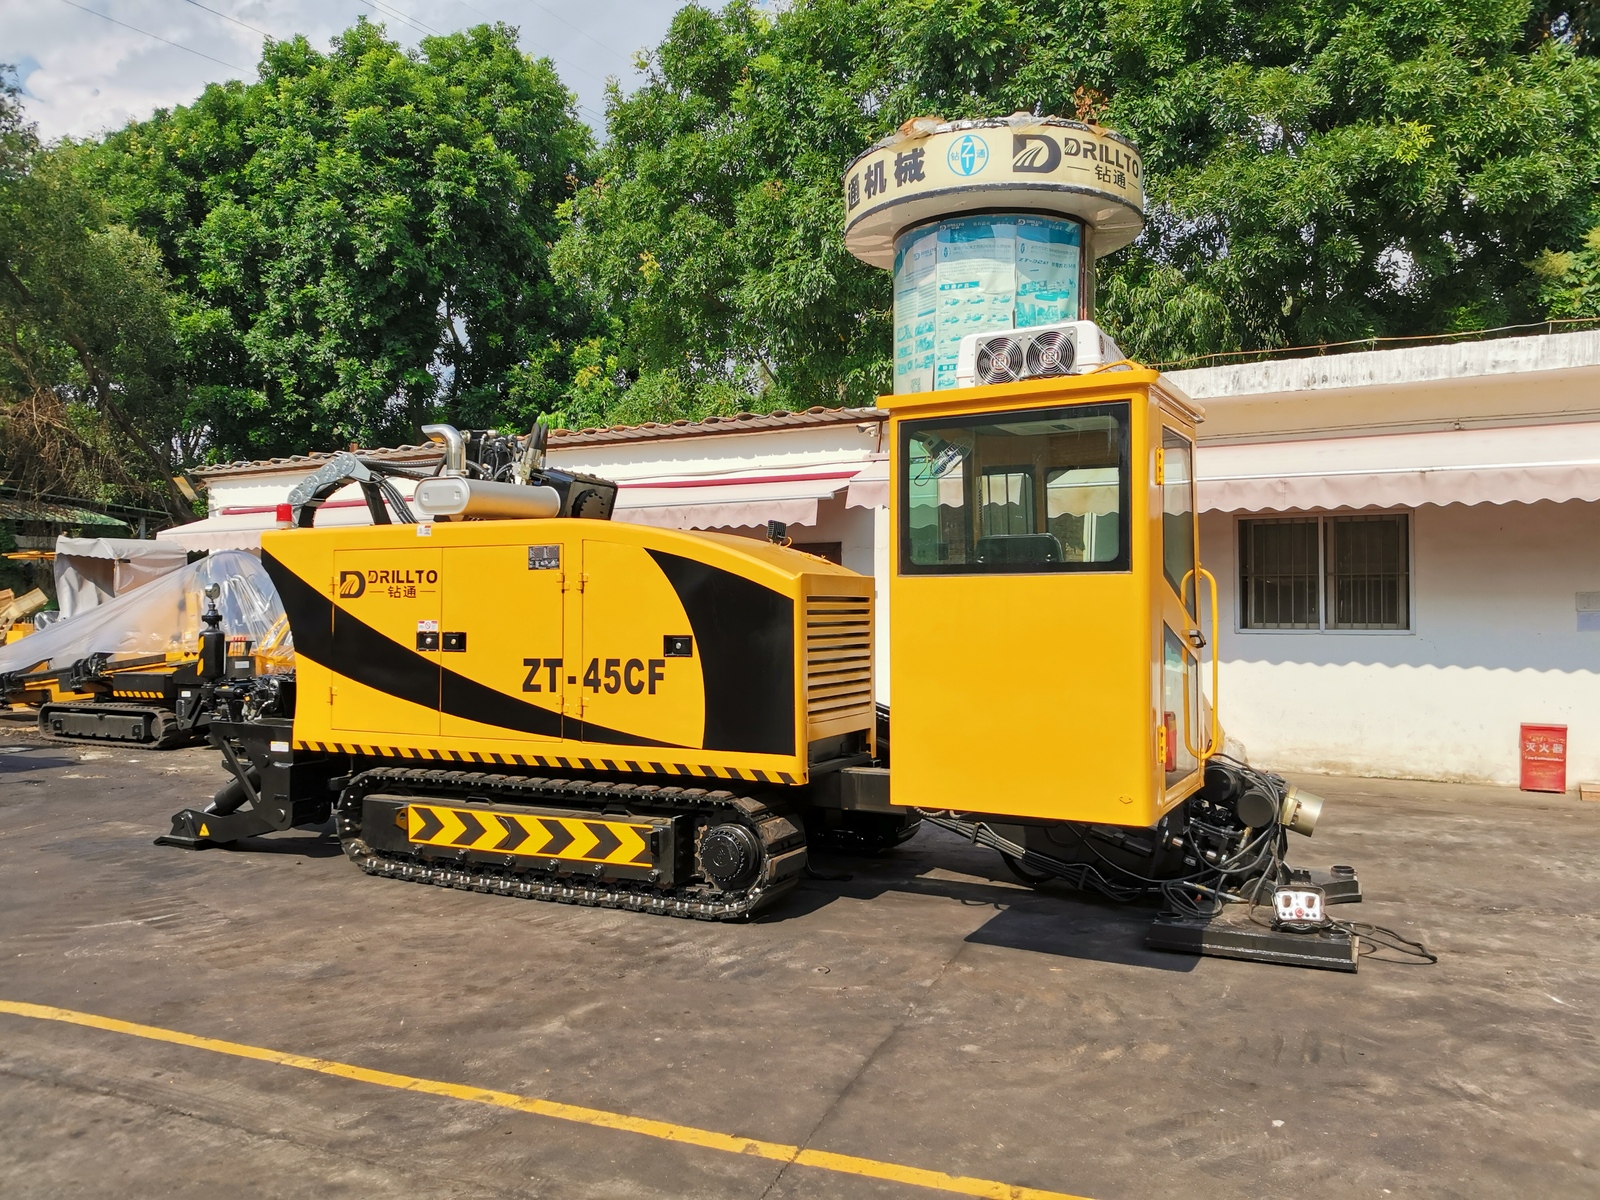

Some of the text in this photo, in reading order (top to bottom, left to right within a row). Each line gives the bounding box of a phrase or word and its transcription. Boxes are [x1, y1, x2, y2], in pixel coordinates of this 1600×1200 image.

[1064, 137, 1139, 179] DRILLTO
[1094, 164, 1127, 190] 钻通
[367, 570, 438, 584] DRILLTO
[387, 585, 417, 599] 钻通
